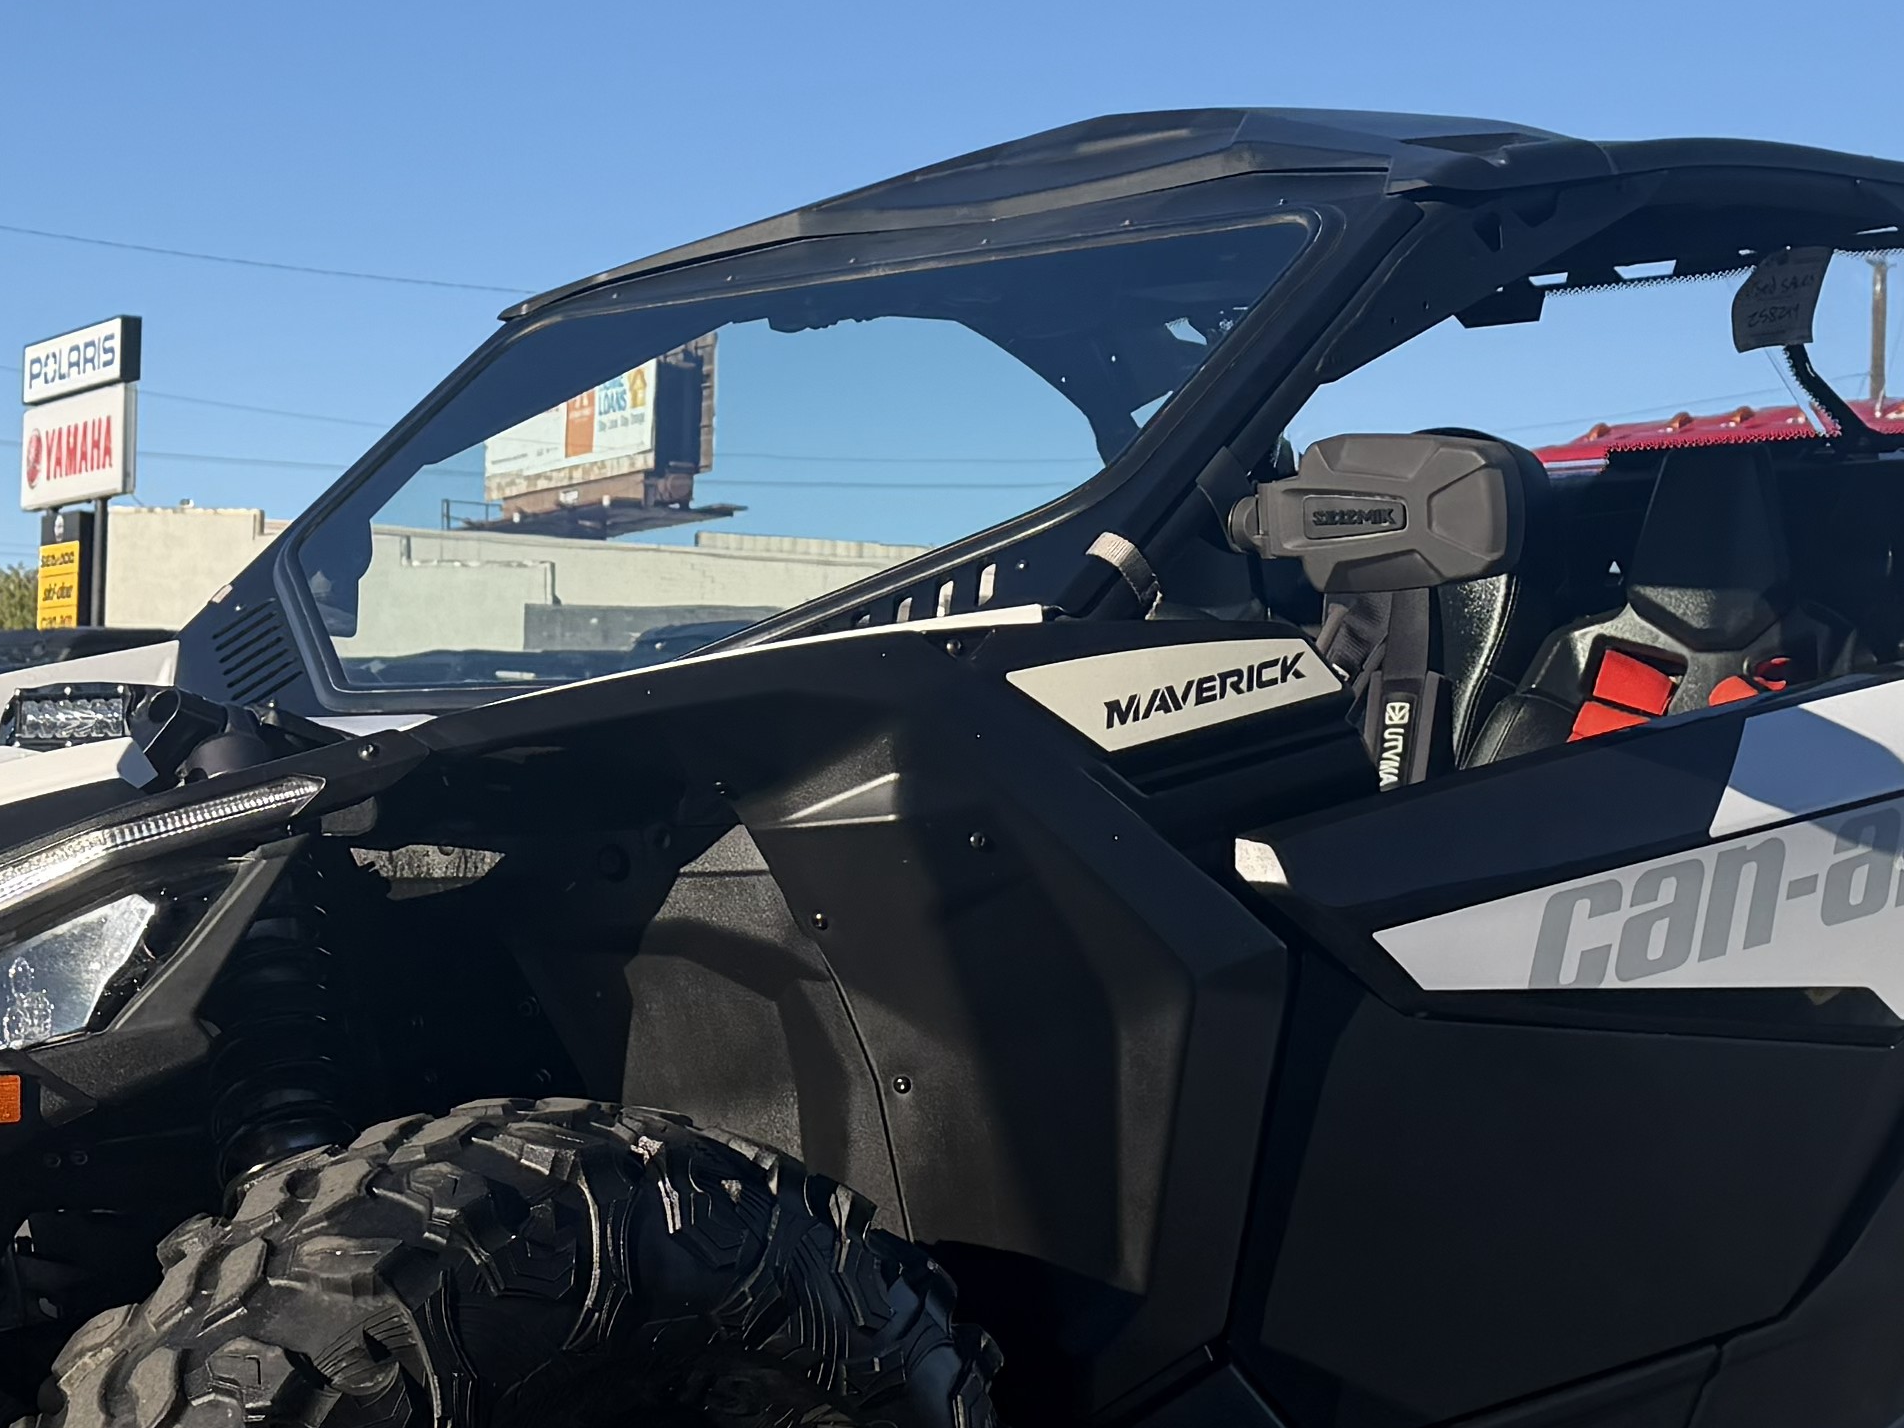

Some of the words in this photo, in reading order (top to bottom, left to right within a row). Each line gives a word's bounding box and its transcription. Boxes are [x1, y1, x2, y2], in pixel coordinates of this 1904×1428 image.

[29, 333, 115, 389] POLARIS
[598, 388, 628, 416] LOANS
[45, 415, 113, 481] YAMAHA
[1103, 651, 1307, 730] MAVERICK
